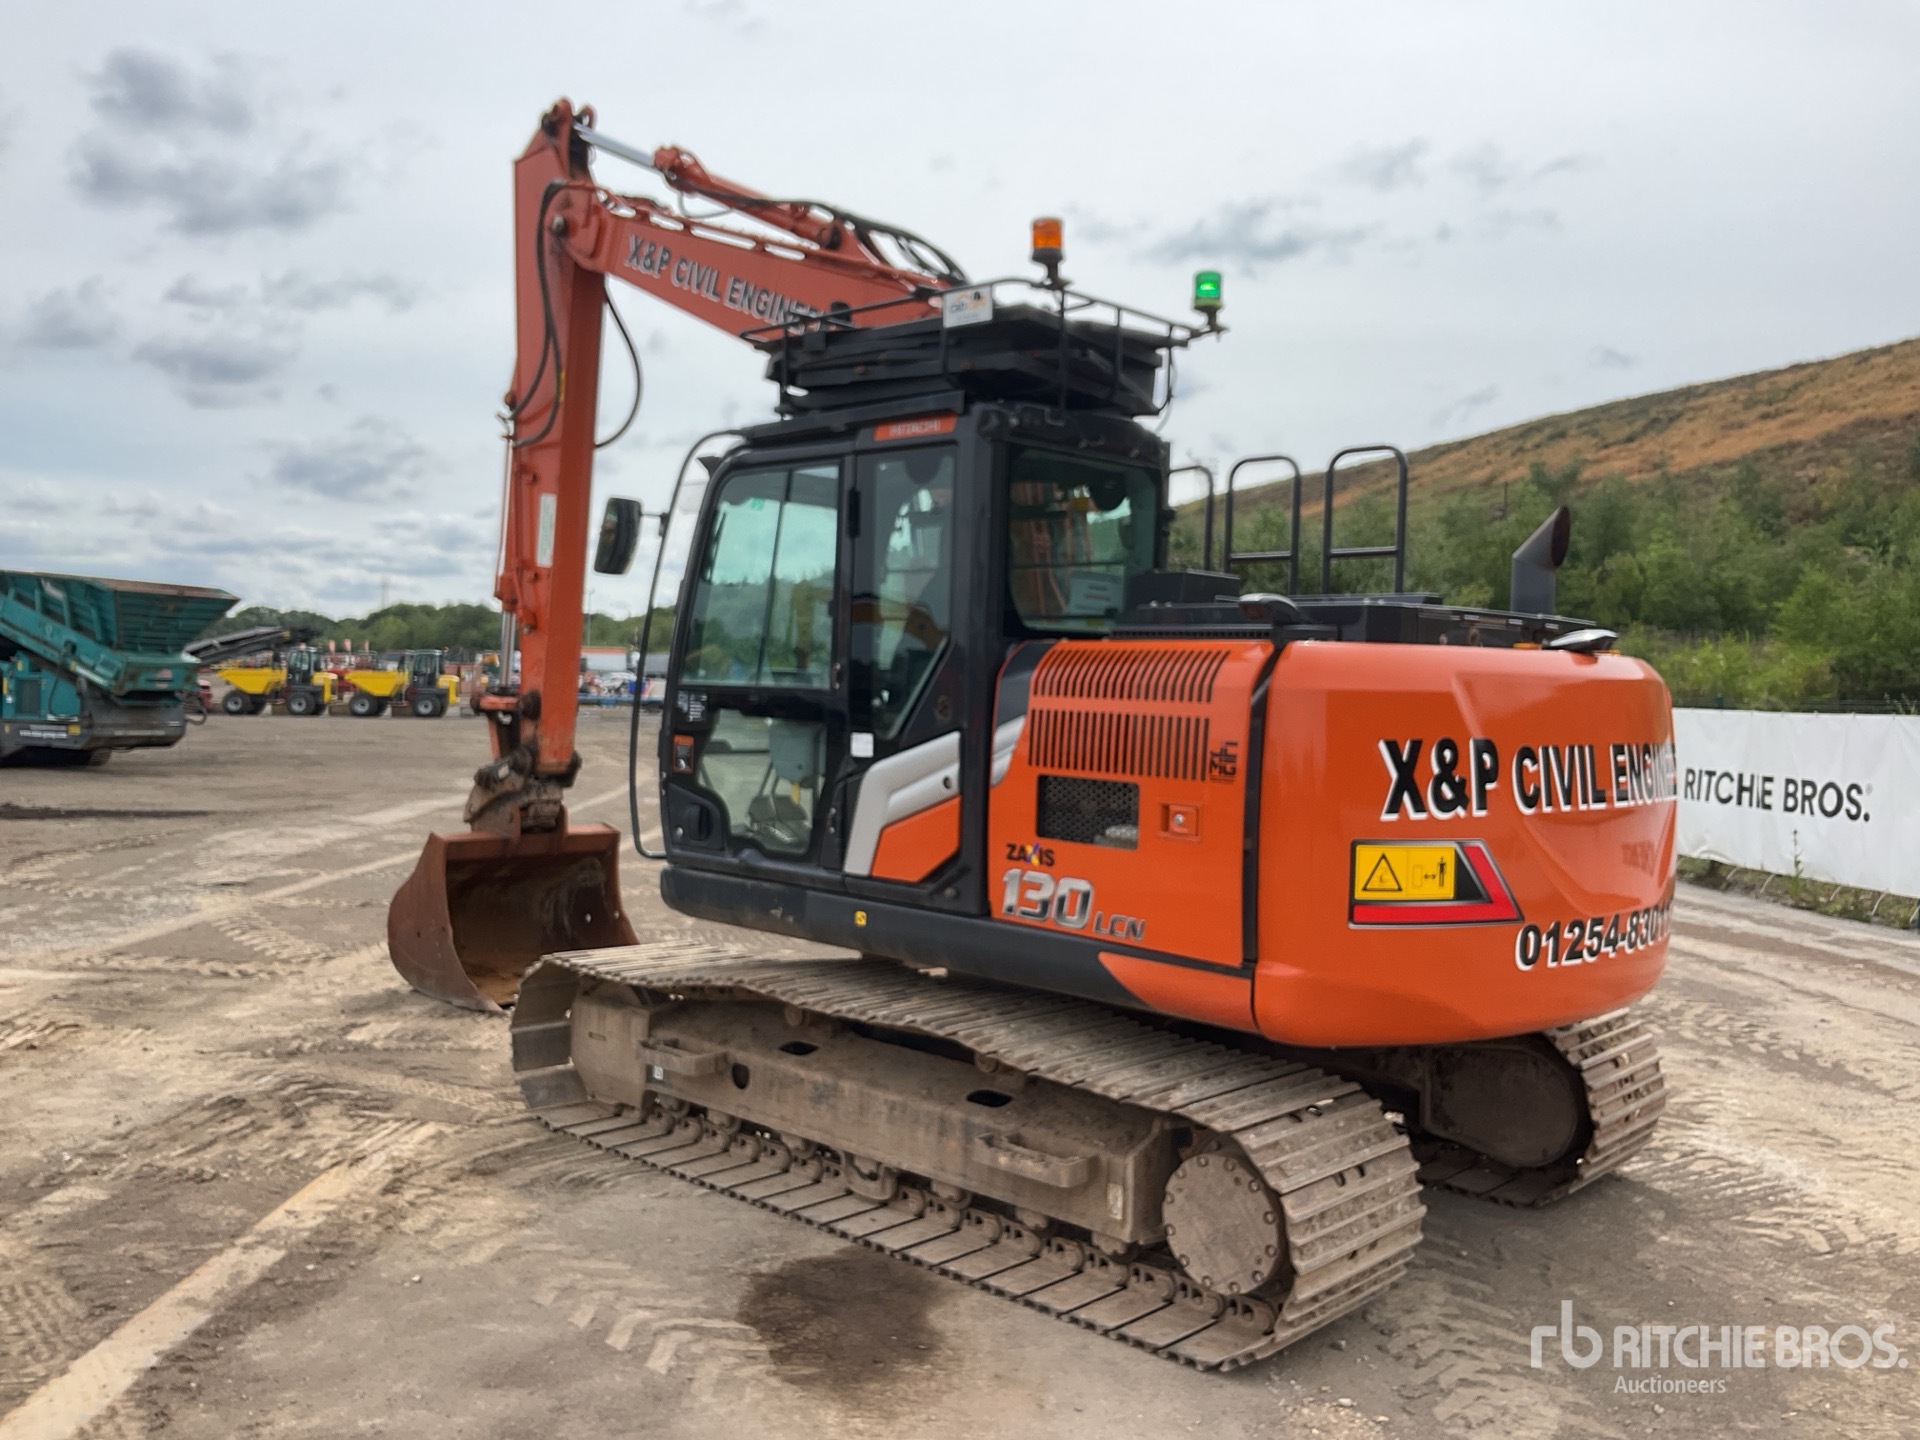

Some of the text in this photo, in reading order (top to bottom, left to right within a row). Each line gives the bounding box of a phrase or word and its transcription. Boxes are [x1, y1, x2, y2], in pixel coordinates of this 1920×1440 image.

[624, 234, 672, 278] X&P
[671, 257, 721, 303] CIVIL
[1378, 738, 1499, 821] X&P
[1511, 744, 1607, 815] CIVIL
[1684, 767, 1870, 823] RITCHIE BROS.
[1006, 842, 1055, 867] ZAXIS
[1002, 868, 1146, 941] 130 LCN
